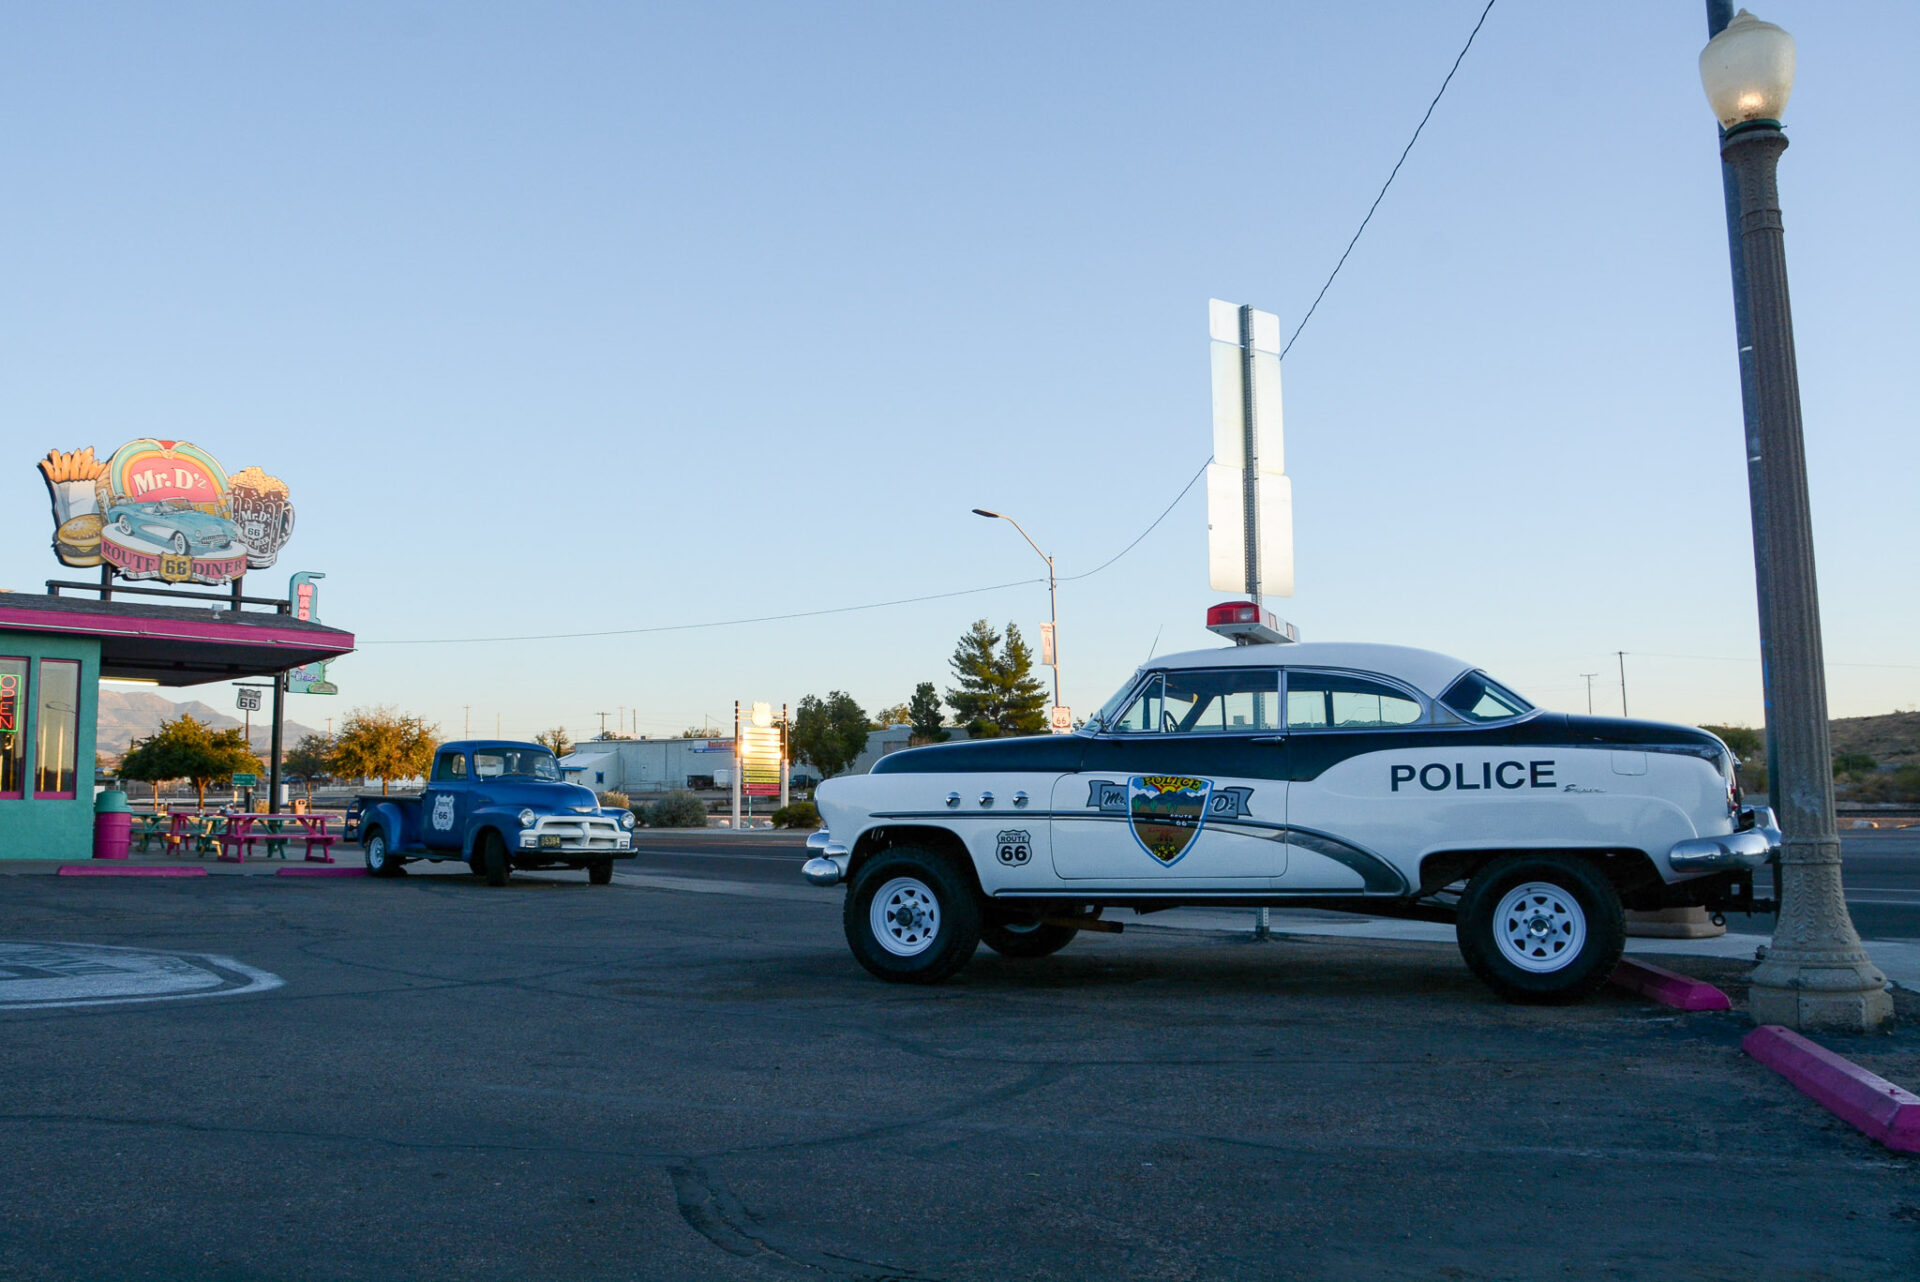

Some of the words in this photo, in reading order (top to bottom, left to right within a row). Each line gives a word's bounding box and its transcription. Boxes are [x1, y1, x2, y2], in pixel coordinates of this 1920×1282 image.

[133, 469, 172, 497] Mr.
[174, 468, 208, 490] D'z
[248, 527, 261, 537] 66
[103, 540, 155, 572] ROUTE
[165, 560, 187, 575] 66
[192, 560, 242, 576] DINER
[0, 675, 17, 730] OPEN
[240, 697, 257, 709] 66
[1056, 716, 1067, 725] 66
[1142, 776, 1203, 791] POLICE
[1391, 760, 1557, 792] POLICE
[1103, 790, 1127, 806] Mr.
[1210, 795, 1236, 813] D'z
[439, 811, 448, 820] 66
[1175, 819, 1188, 827] 66
[1001, 845, 1028, 862] 66
